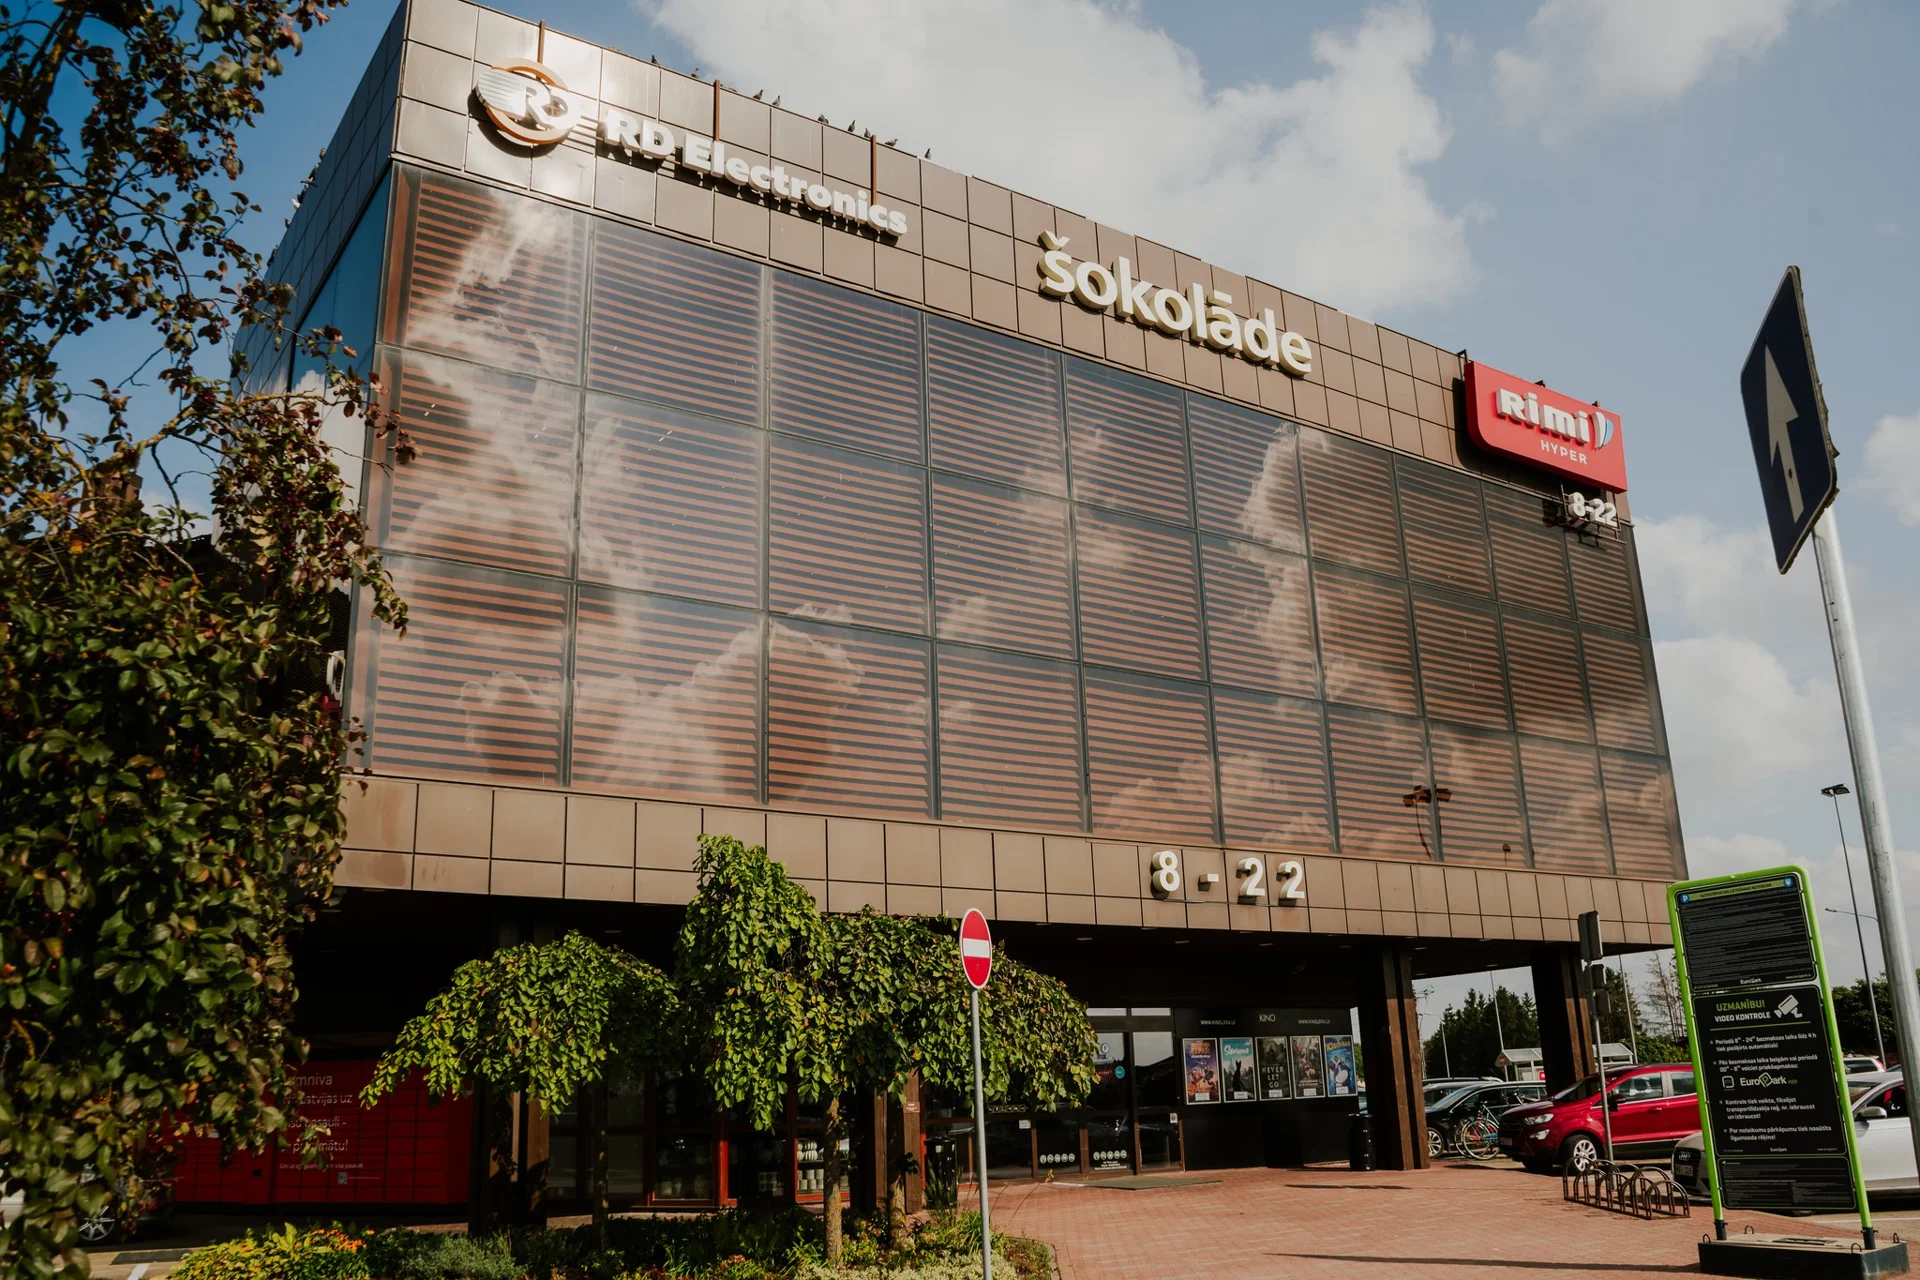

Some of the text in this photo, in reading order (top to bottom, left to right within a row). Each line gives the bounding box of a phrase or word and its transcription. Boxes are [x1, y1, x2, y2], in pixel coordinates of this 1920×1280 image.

[602, 107, 908, 237] RD Electronics
[1038, 230, 1312, 376] šokolāde
[1496, 388, 1590, 444] Rimi
[1540, 440, 1588, 465] HYPER
[1568, 491, 1618, 528] 8-22
[1152, 851, 1180, 892] 8
[1716, 999, 1766, 1012] UZMANĪBU!
[1259, 1013, 1276, 1022] KINO
[1714, 1011, 1771, 1022] VIDEO KONTROLE
[1262, 1066, 1284, 1074] NEVER
[1740, 1072, 1787, 1087] EuroPark
[340, 1095, 353, 1104] uz
